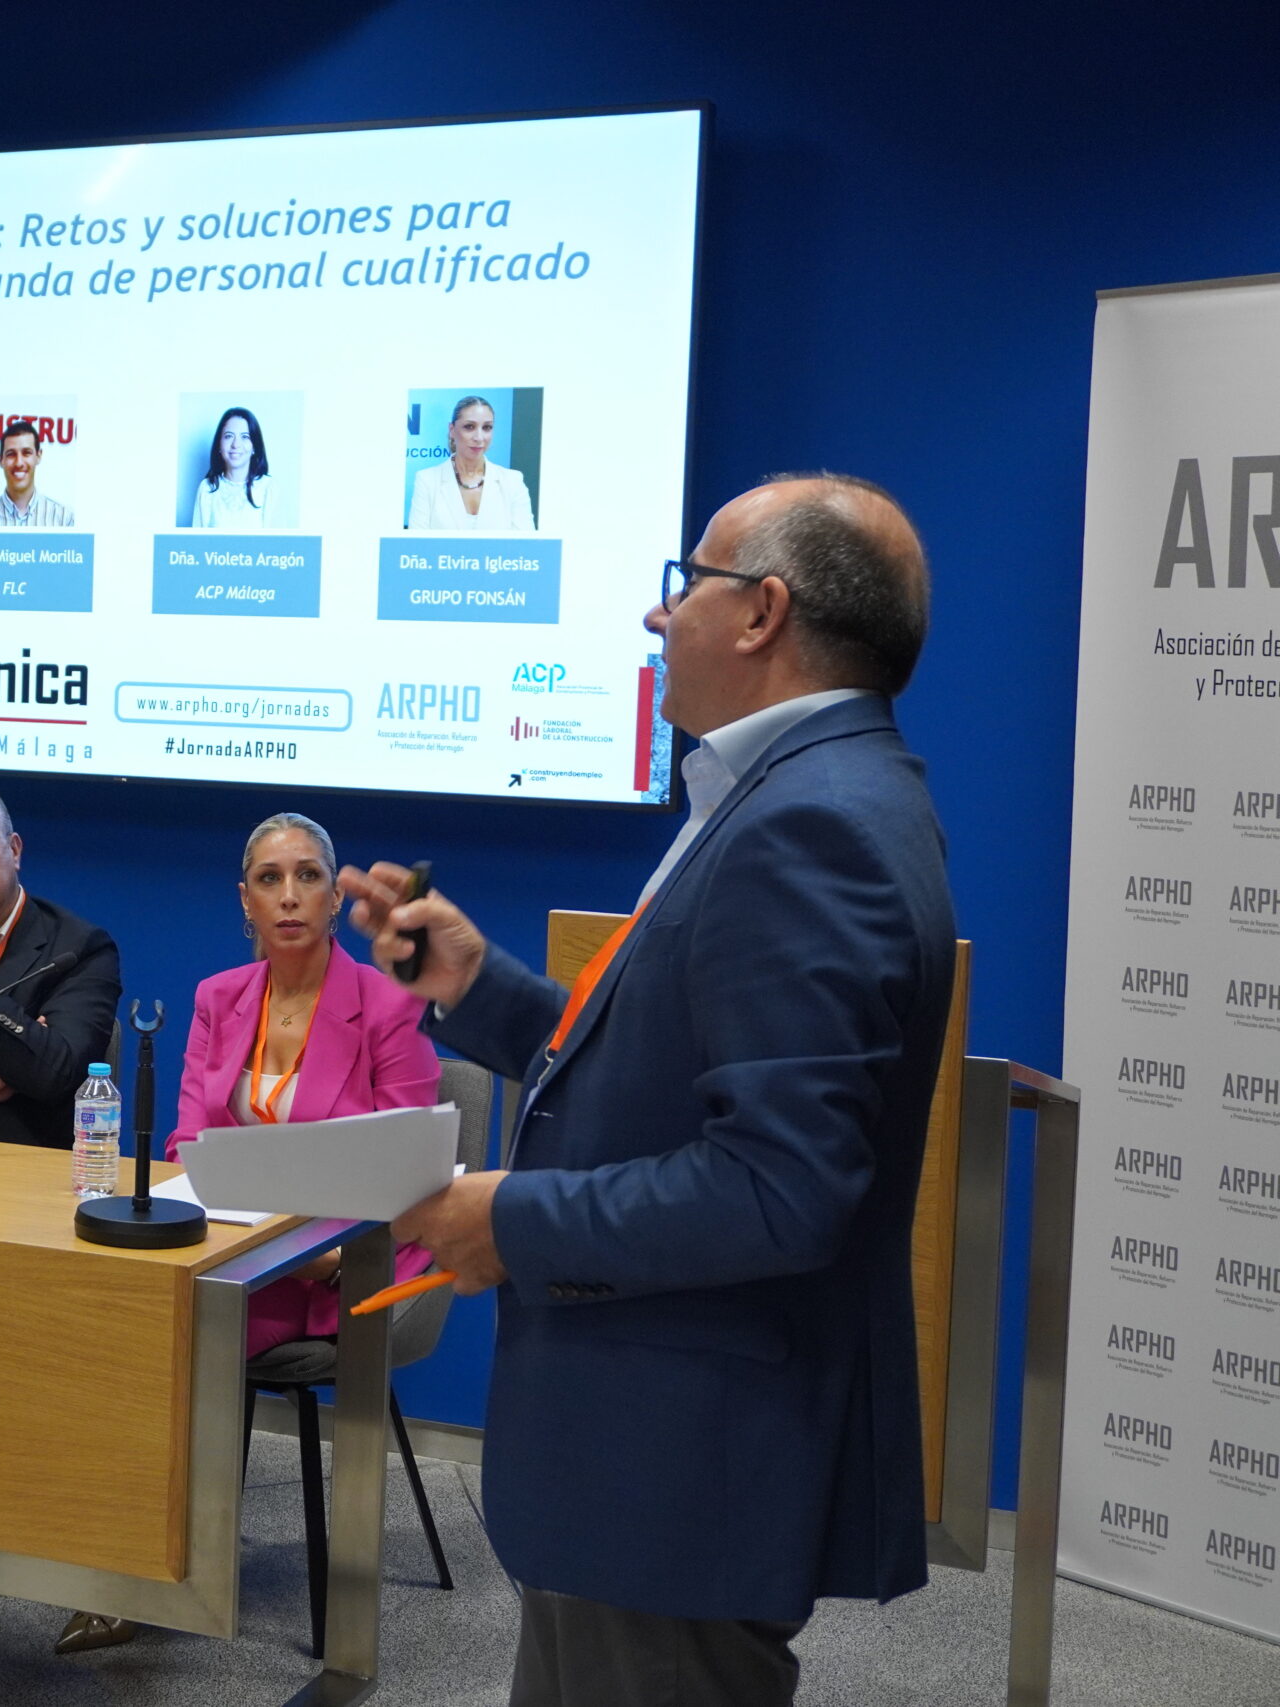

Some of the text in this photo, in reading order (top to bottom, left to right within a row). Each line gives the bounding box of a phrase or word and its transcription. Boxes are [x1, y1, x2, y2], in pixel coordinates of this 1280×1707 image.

[19, 213, 128, 248] Retos
[140, 215, 165, 252] y
[177, 198, 393, 241] soluciones
[405, 199, 511, 241] para
[88, 259, 136, 297] de
[147, 250, 327, 303] personal
[341, 241, 591, 294] cualificado
[39, 550, 84, 564] Morilla
[169, 551, 305, 570] Dña. Violeta Aragón
[399, 554, 540, 574] Dña. Elvira Iglesias
[2, 582, 27, 596] FLC
[195, 585, 276, 603] ACP Málaga
[410, 588, 526, 607] GRUPO FONSÁN
[1154, 627, 1255, 657] Asociación
[513, 662, 567, 693] ACP
[1196, 669, 1280, 701] y Protec
[136, 695, 330, 719] www.arpho.org/jornadas
[376, 682, 481, 723] ARPHO
[165, 737, 298, 760] #JornadaARPHO
[1129, 784, 1195, 812] ARPHO
[1125, 876, 1192, 905] ARPHO
[1122, 966, 1188, 998] ARPHO
[1118, 1057, 1185, 1090] ARPHO
[1222, 1072, 1280, 1105] ARPH
[1114, 1146, 1182, 1181] ARPHO
[1111, 1236, 1178, 1272] ARPHO
[1107, 1324, 1175, 1361] ARPHO
[1104, 1412, 1172, 1450] ARPHO
[1209, 1439, 1280, 1479] ARPHO
[1100, 1500, 1168, 1539] ARPHO
[1205, 1529, 1276, 1571] ARPHO
